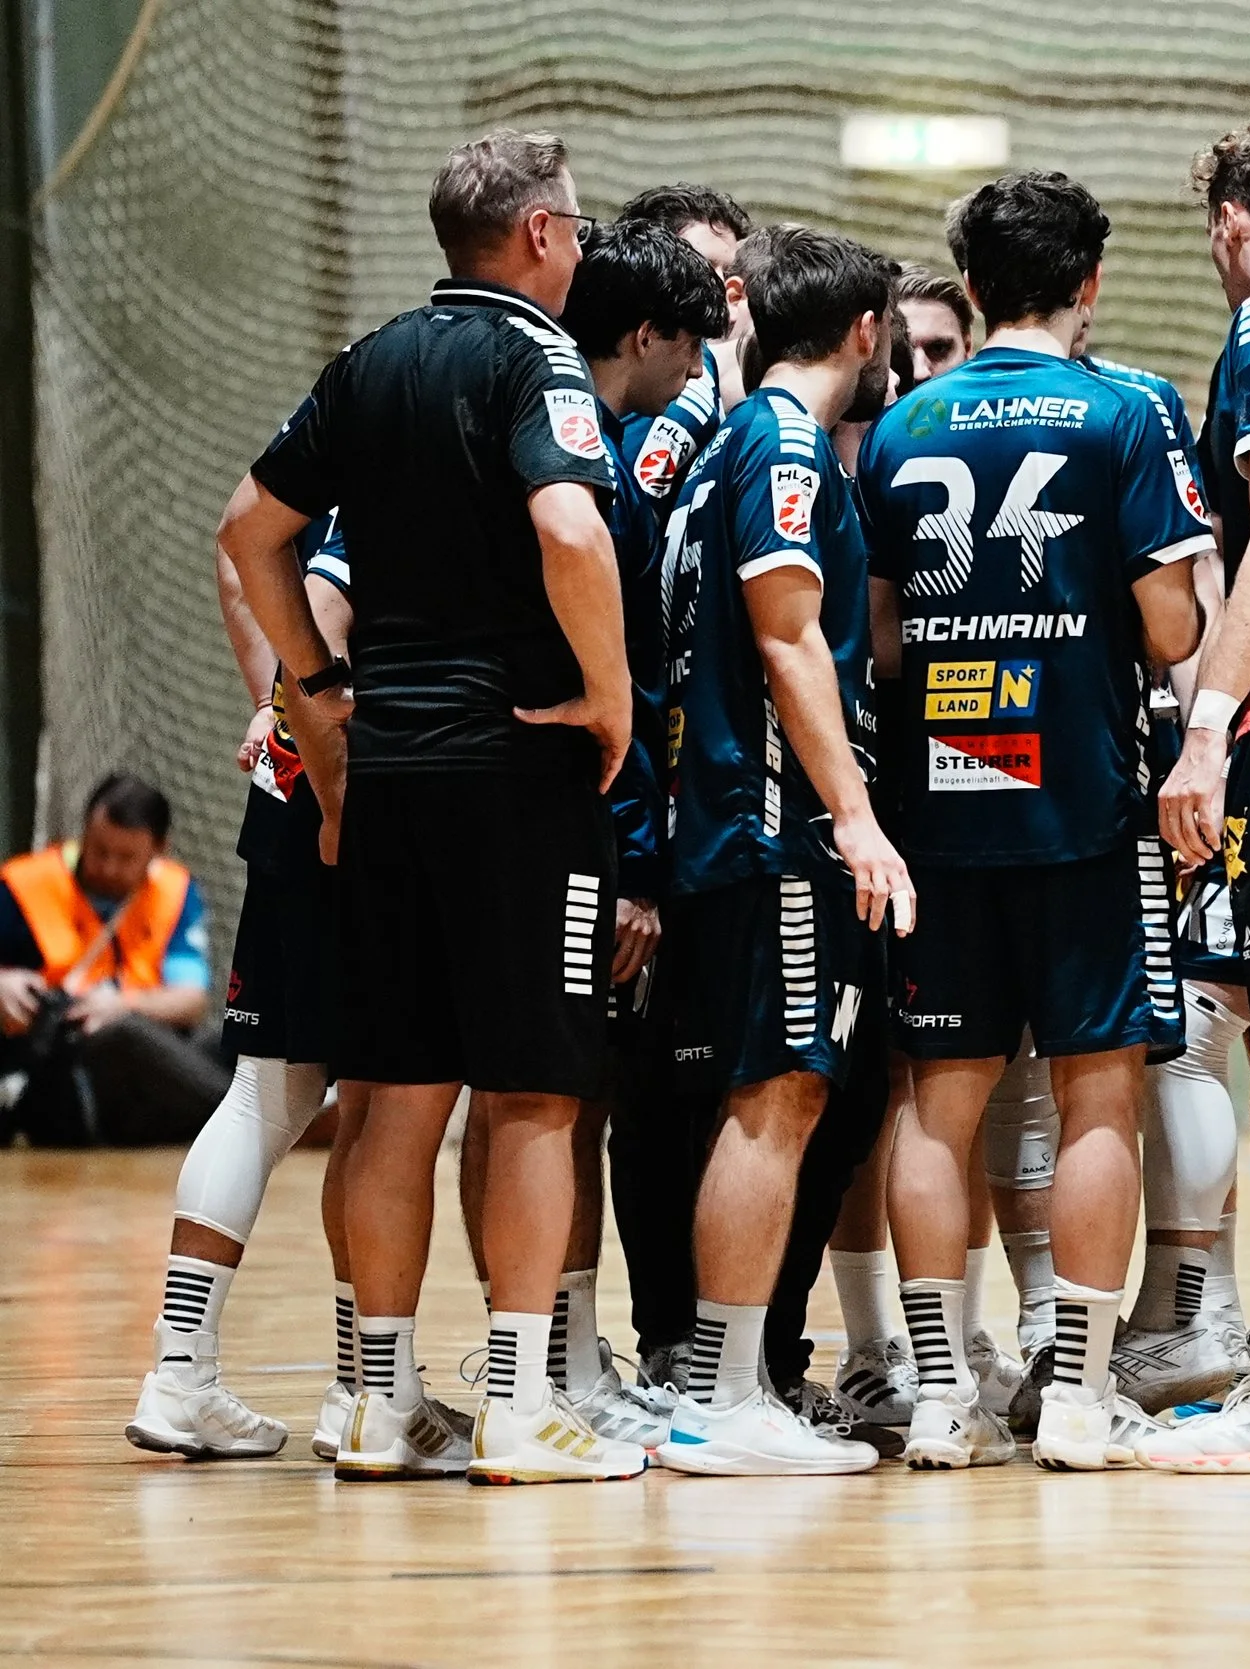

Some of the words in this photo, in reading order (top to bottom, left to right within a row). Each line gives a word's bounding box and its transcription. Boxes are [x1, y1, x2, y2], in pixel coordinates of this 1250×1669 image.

[553, 394, 593, 407] HLA
[951, 396, 1089, 422] LAHNER
[657, 423, 692, 457] HLA
[777, 469, 813, 489] HLA
[890, 451, 1085, 598] 34
[935, 667, 988, 683] SPORT
[936, 698, 980, 714] LAND
[935, 754, 1031, 770] STEURER
